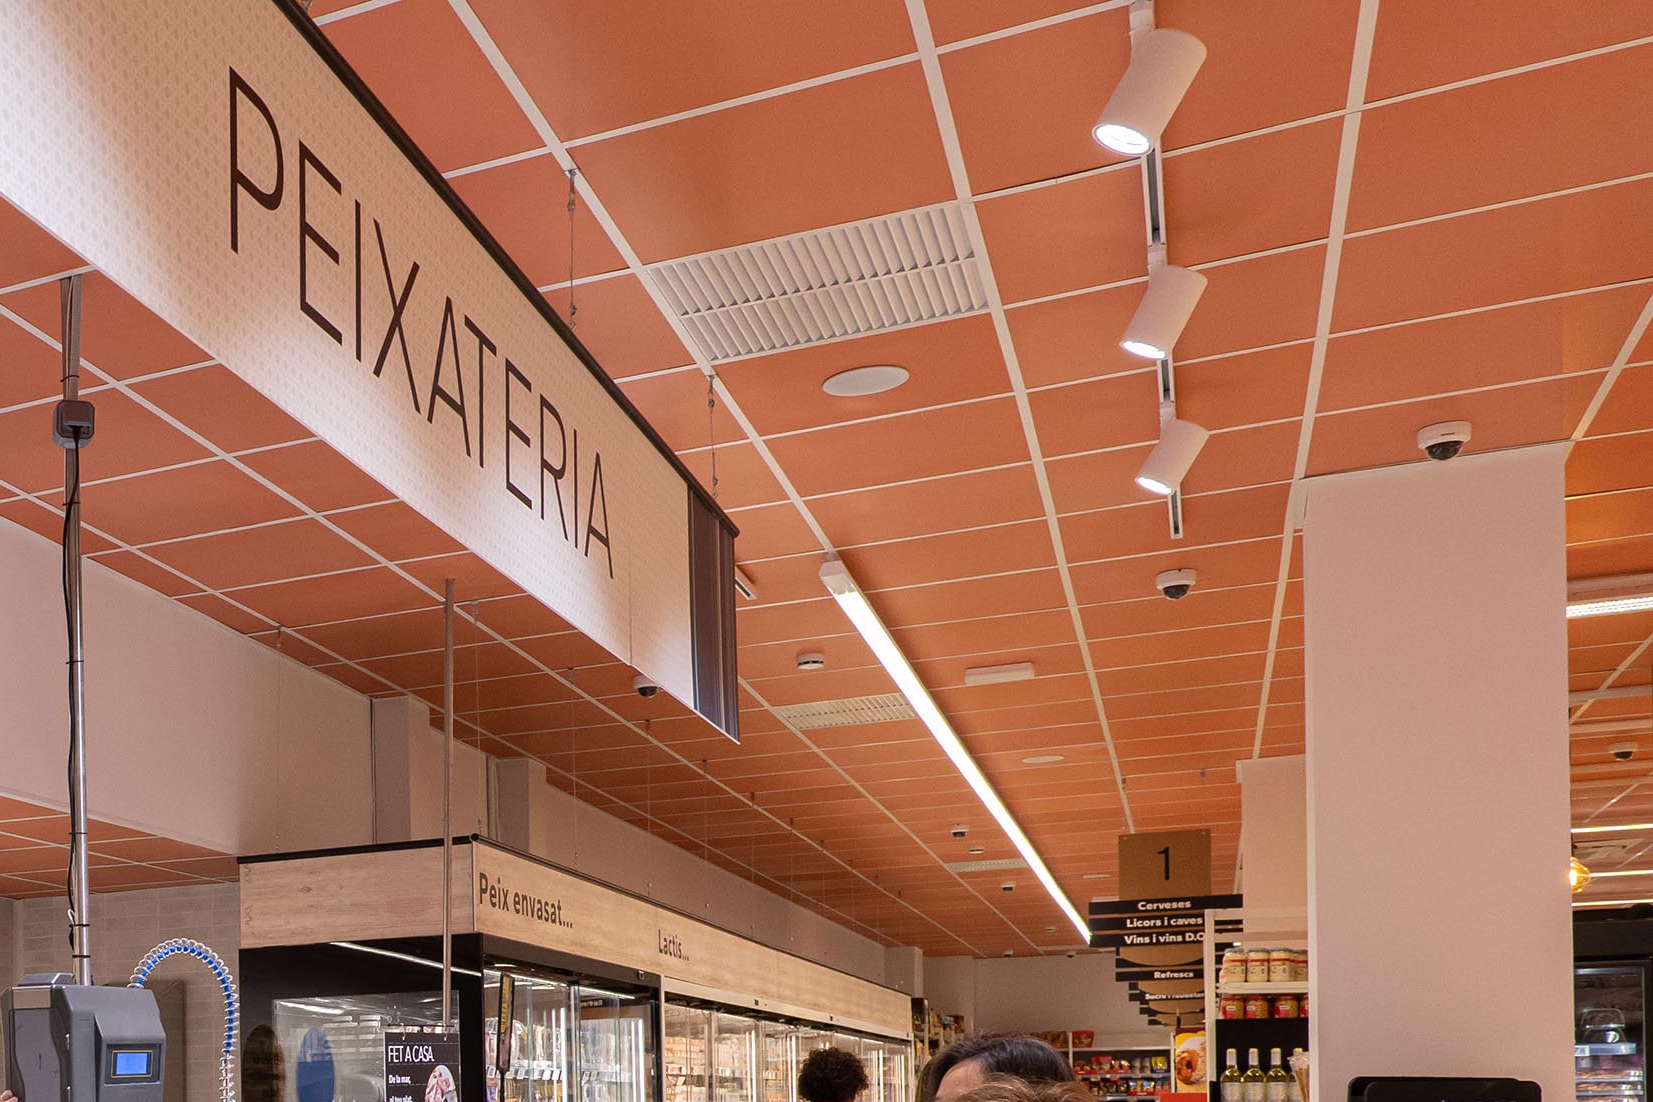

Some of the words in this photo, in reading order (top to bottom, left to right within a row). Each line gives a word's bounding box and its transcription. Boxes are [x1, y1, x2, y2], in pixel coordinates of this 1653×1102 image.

[229, 66, 614, 579] PEIXATERIA
[1157, 847, 1170, 880] 1
[479, 872, 509, 911] Peix
[1138, 900, 1191, 910] Cerveses
[1126, 919, 1162, 928] Licors
[1170, 917, 1203, 926] caves
[1124, 935, 1150, 944] Vins
[1159, 932, 1183, 942] vins
[1154, 971, 1194, 979] Refrescs
[388, 1046, 404, 1062] FET
[405, 1046, 412, 1062] A
